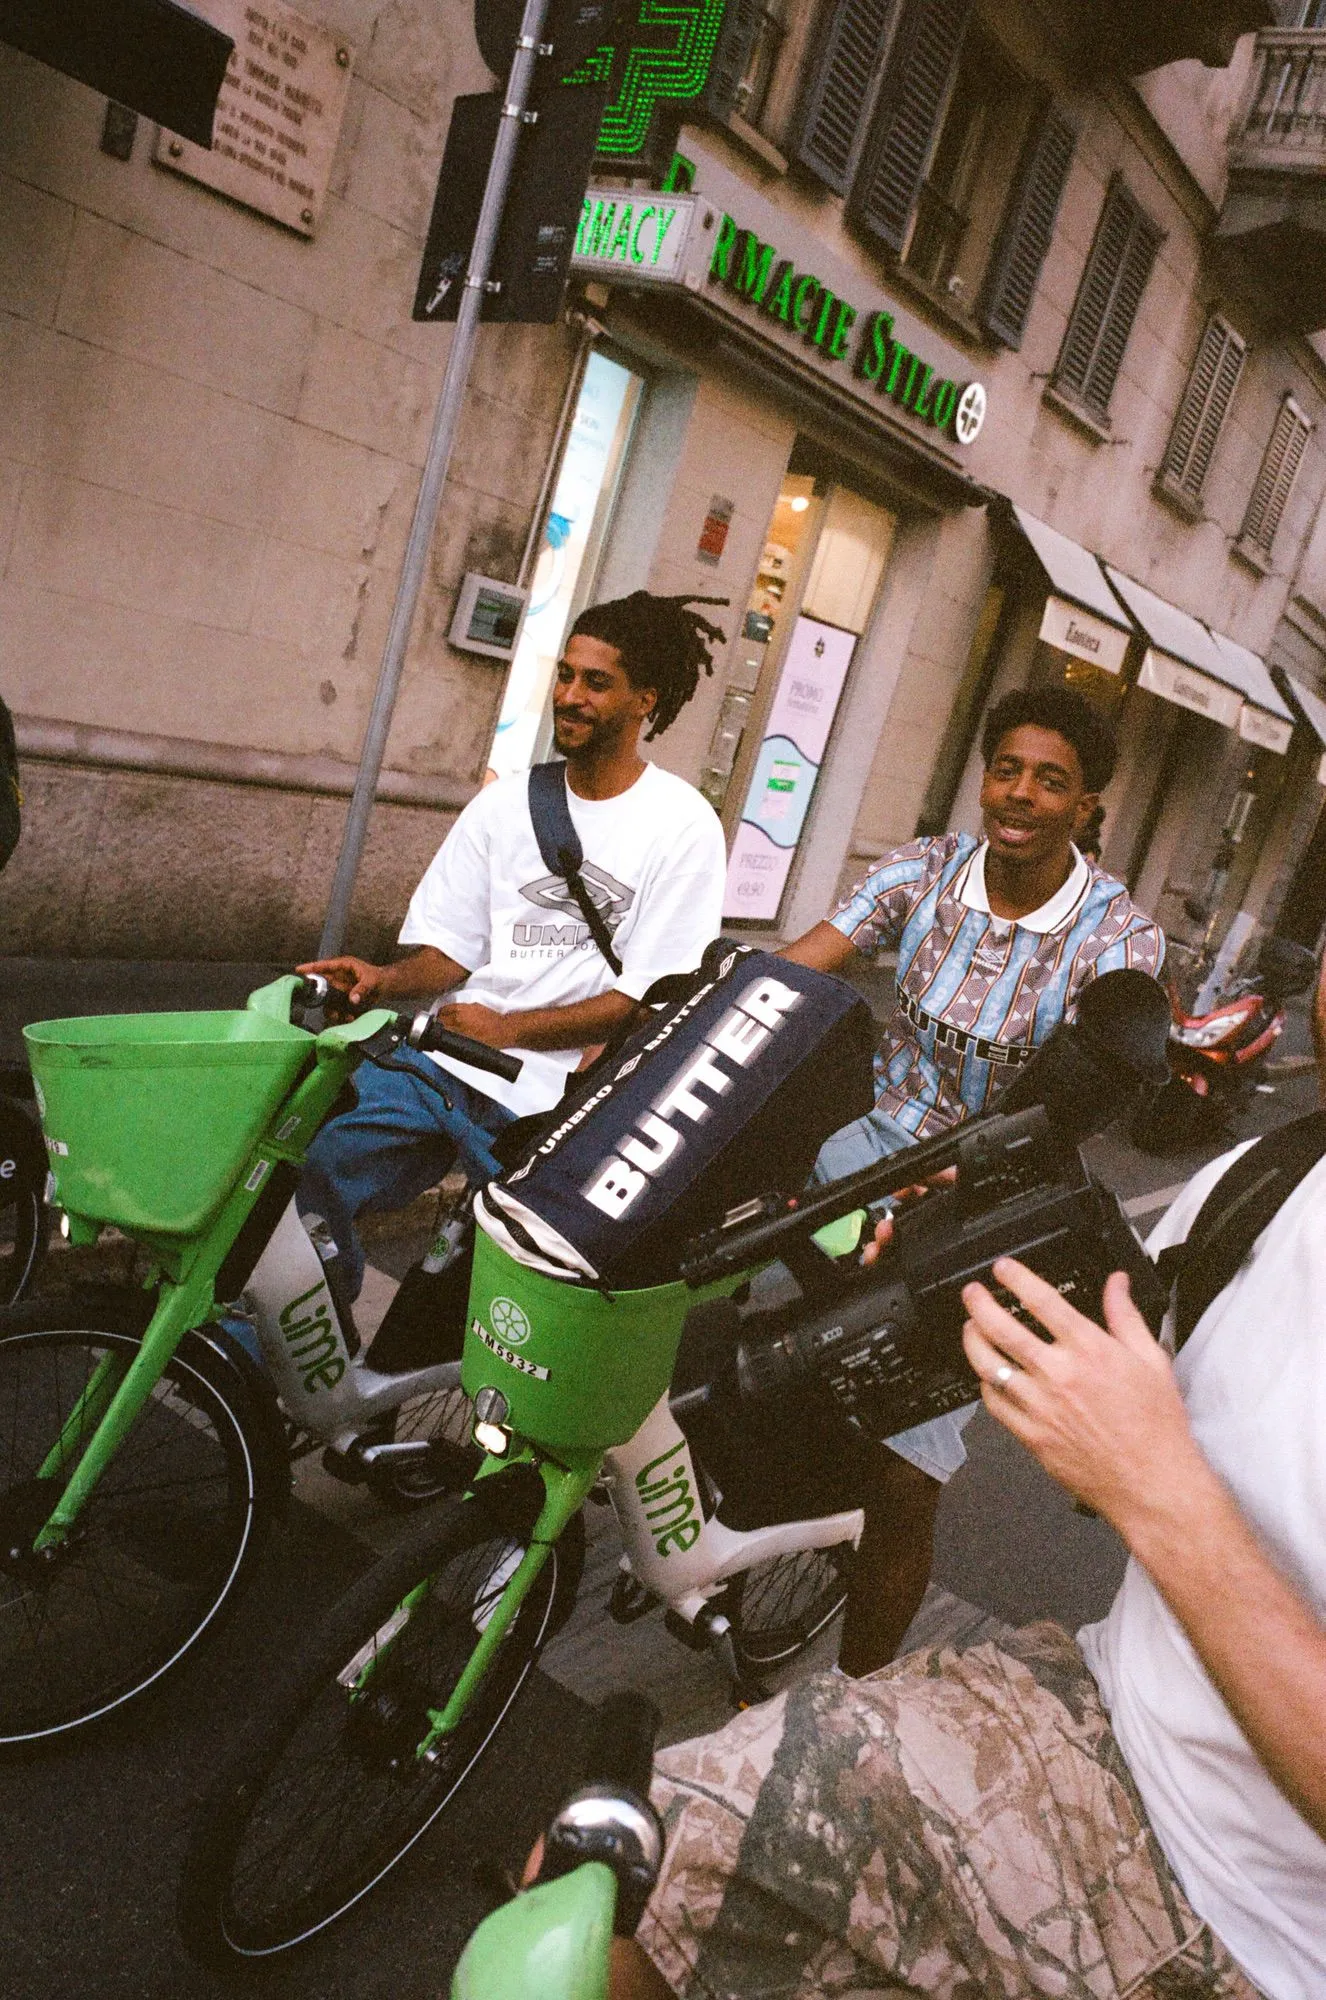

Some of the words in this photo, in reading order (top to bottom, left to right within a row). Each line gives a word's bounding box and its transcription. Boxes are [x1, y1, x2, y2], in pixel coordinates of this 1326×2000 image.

[510, 949, 564, 959] BUTTER
[644, 983, 716, 1051] BUTTER
[538, 1084, 613, 1155] UMBRO
[583, 975, 803, 1221] BUTTER
[477, 1325, 538, 1377] LM5932
